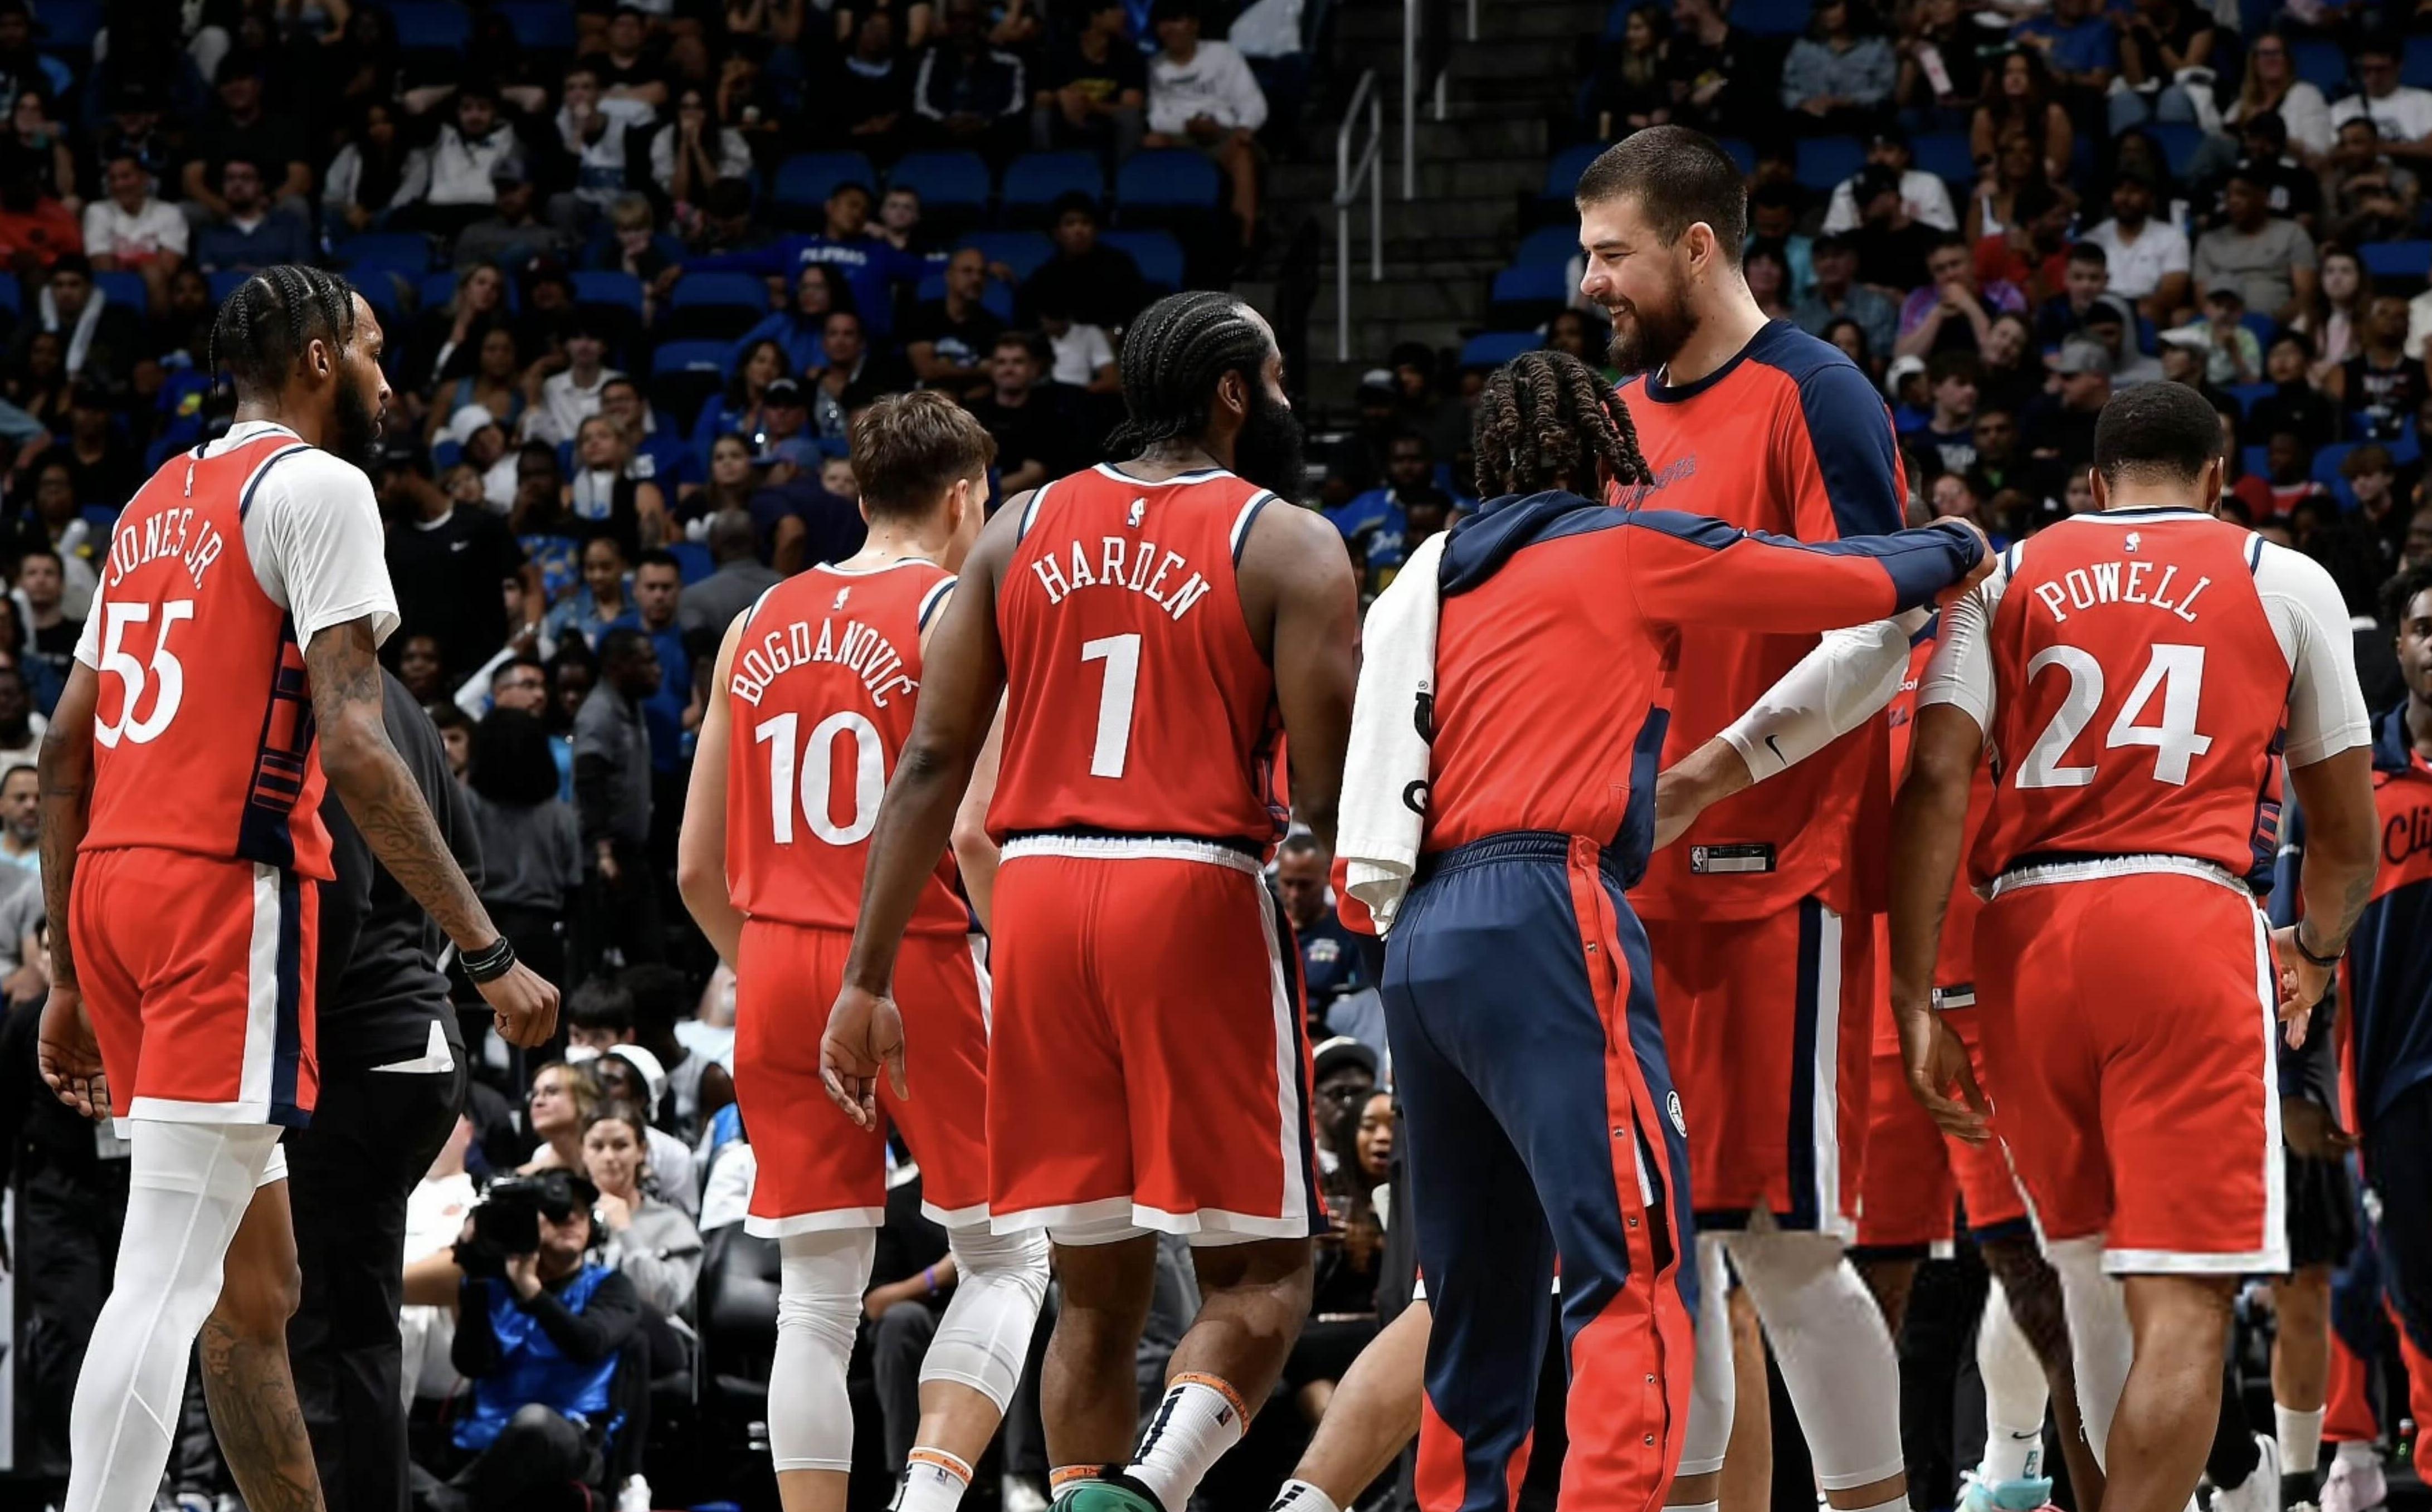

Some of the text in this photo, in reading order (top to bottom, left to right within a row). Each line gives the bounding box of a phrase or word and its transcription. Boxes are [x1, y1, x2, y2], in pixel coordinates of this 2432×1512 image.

[110, 508, 222, 590] JONES JR.
[1031, 536, 1211, 621] HARDEN
[2034, 560, 2211, 623] POWELL
[95, 599, 194, 749] 55
[731, 617, 920, 708] BOGDANOVIĆ
[1081, 633, 1141, 778] 1
[2015, 643, 2213, 789] 24
[755, 710, 886, 846] 10
[2384, 806, 2432, 865] Cli
